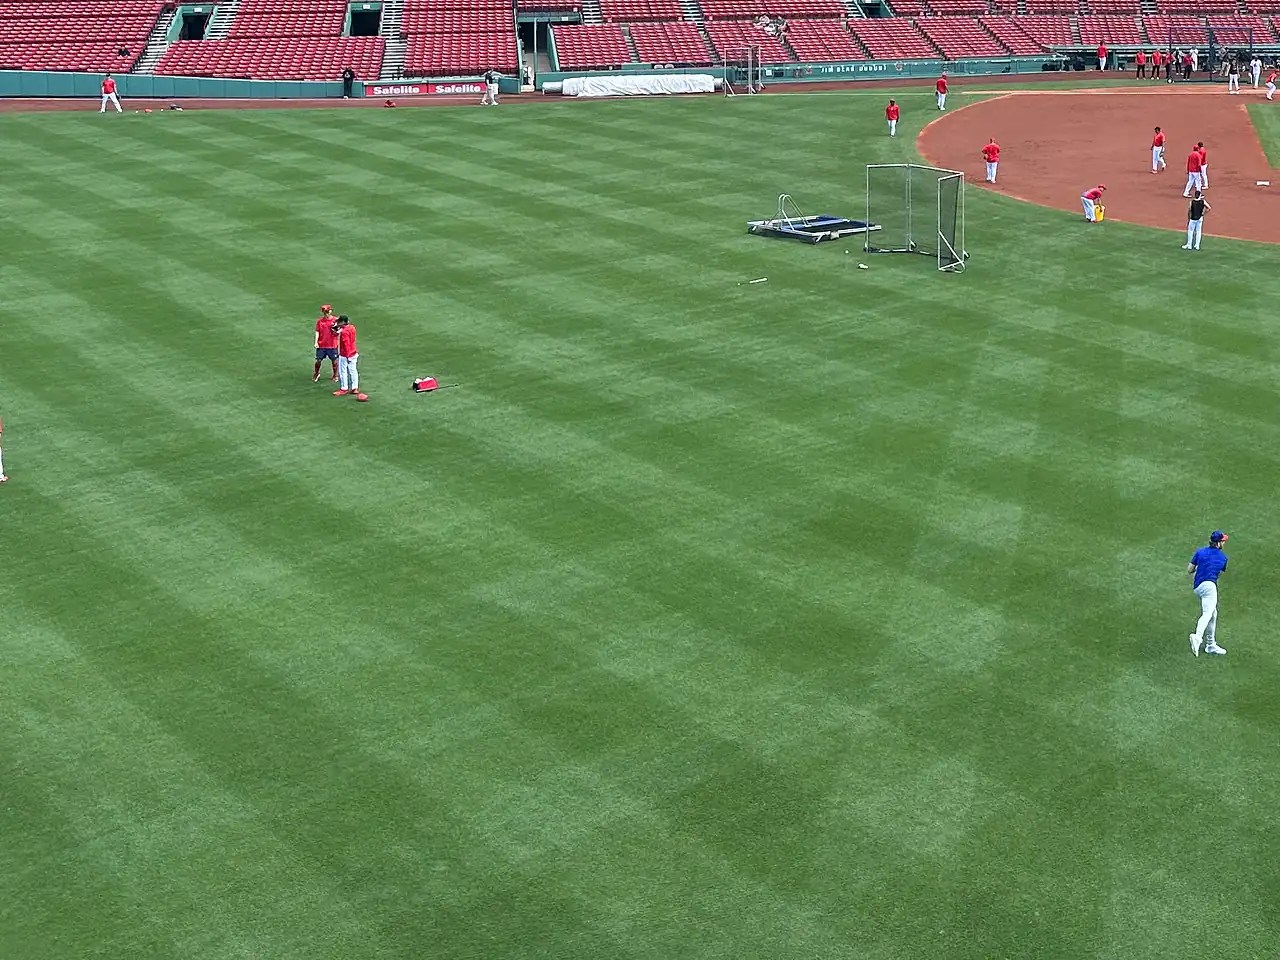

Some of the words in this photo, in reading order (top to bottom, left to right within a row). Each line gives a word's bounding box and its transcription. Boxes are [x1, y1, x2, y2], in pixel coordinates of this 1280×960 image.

[821, 65, 834, 73] JIM
[836, 64, 855, 72] BEAM
[859, 64, 887, 72] DUGOUT
[373, 86, 420, 95] Safelite
[435, 84, 481, 93] Safelite
